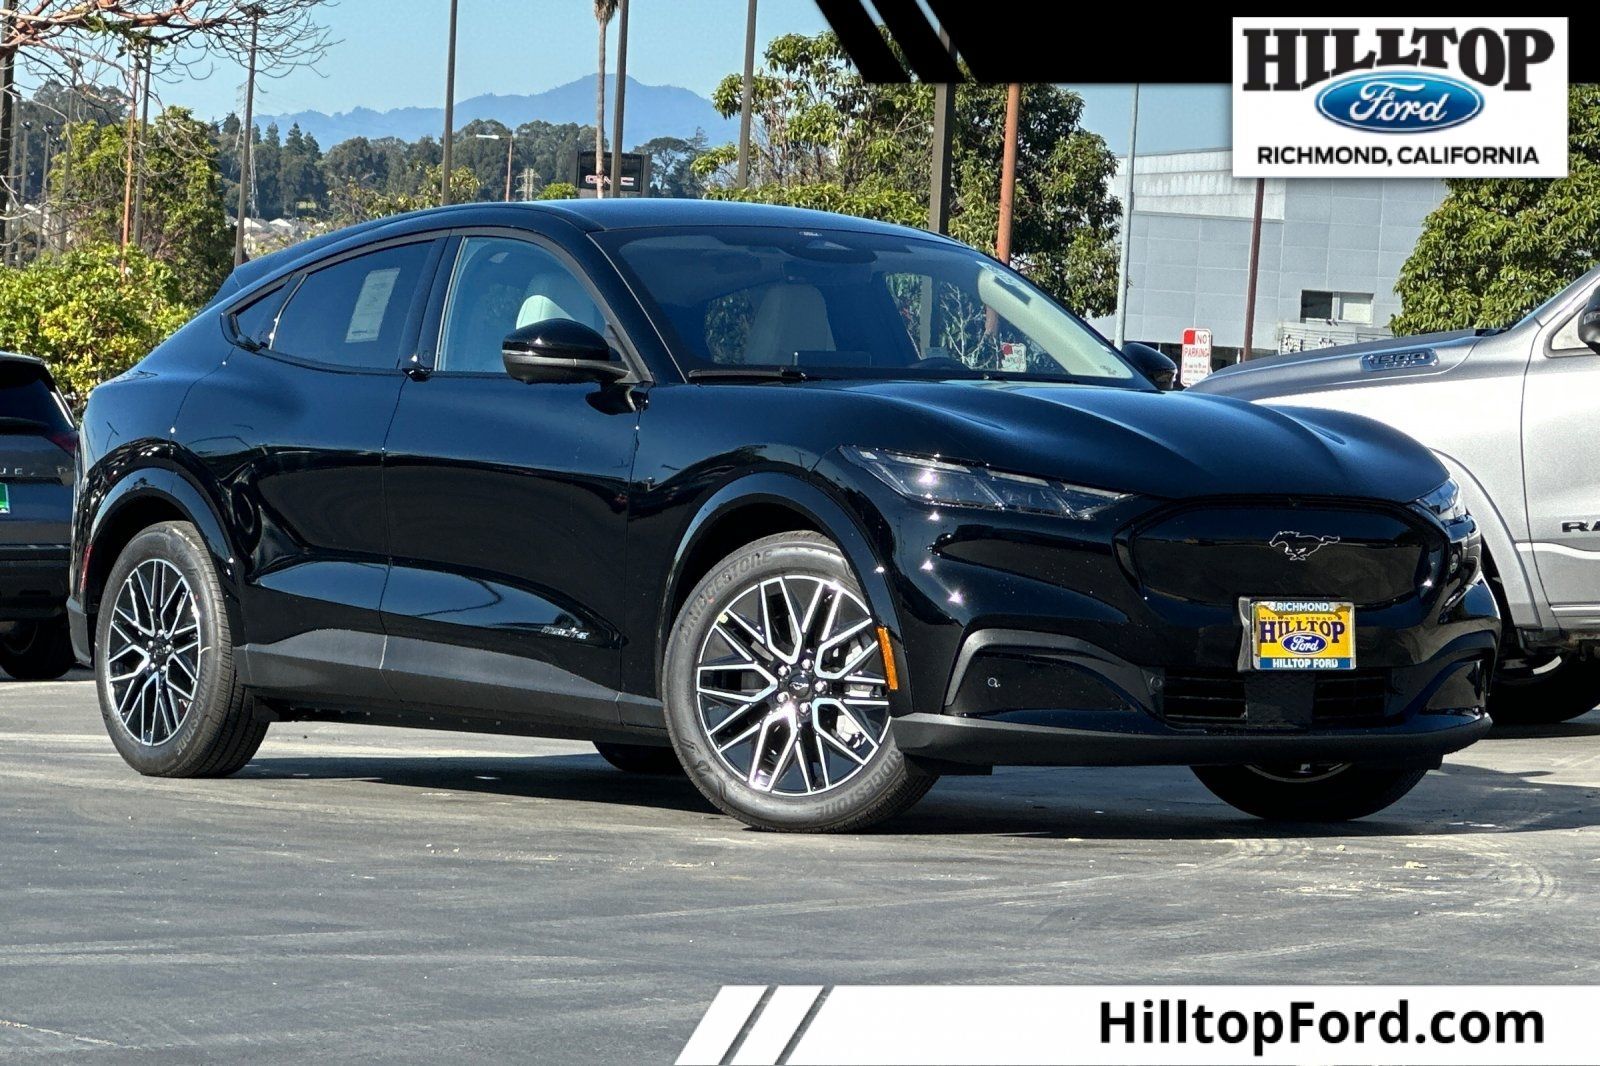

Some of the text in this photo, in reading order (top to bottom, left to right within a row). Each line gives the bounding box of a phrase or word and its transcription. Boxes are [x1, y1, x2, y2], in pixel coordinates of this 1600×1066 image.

[1197, 334, 1208, 345] NO
[1277, 602, 1329, 612] RICHMOND
[1259, 620, 1345, 643] HILLTOP
[1290, 635, 1319, 651] Ford
[1272, 658, 1338, 668] HILLTOP FORD
